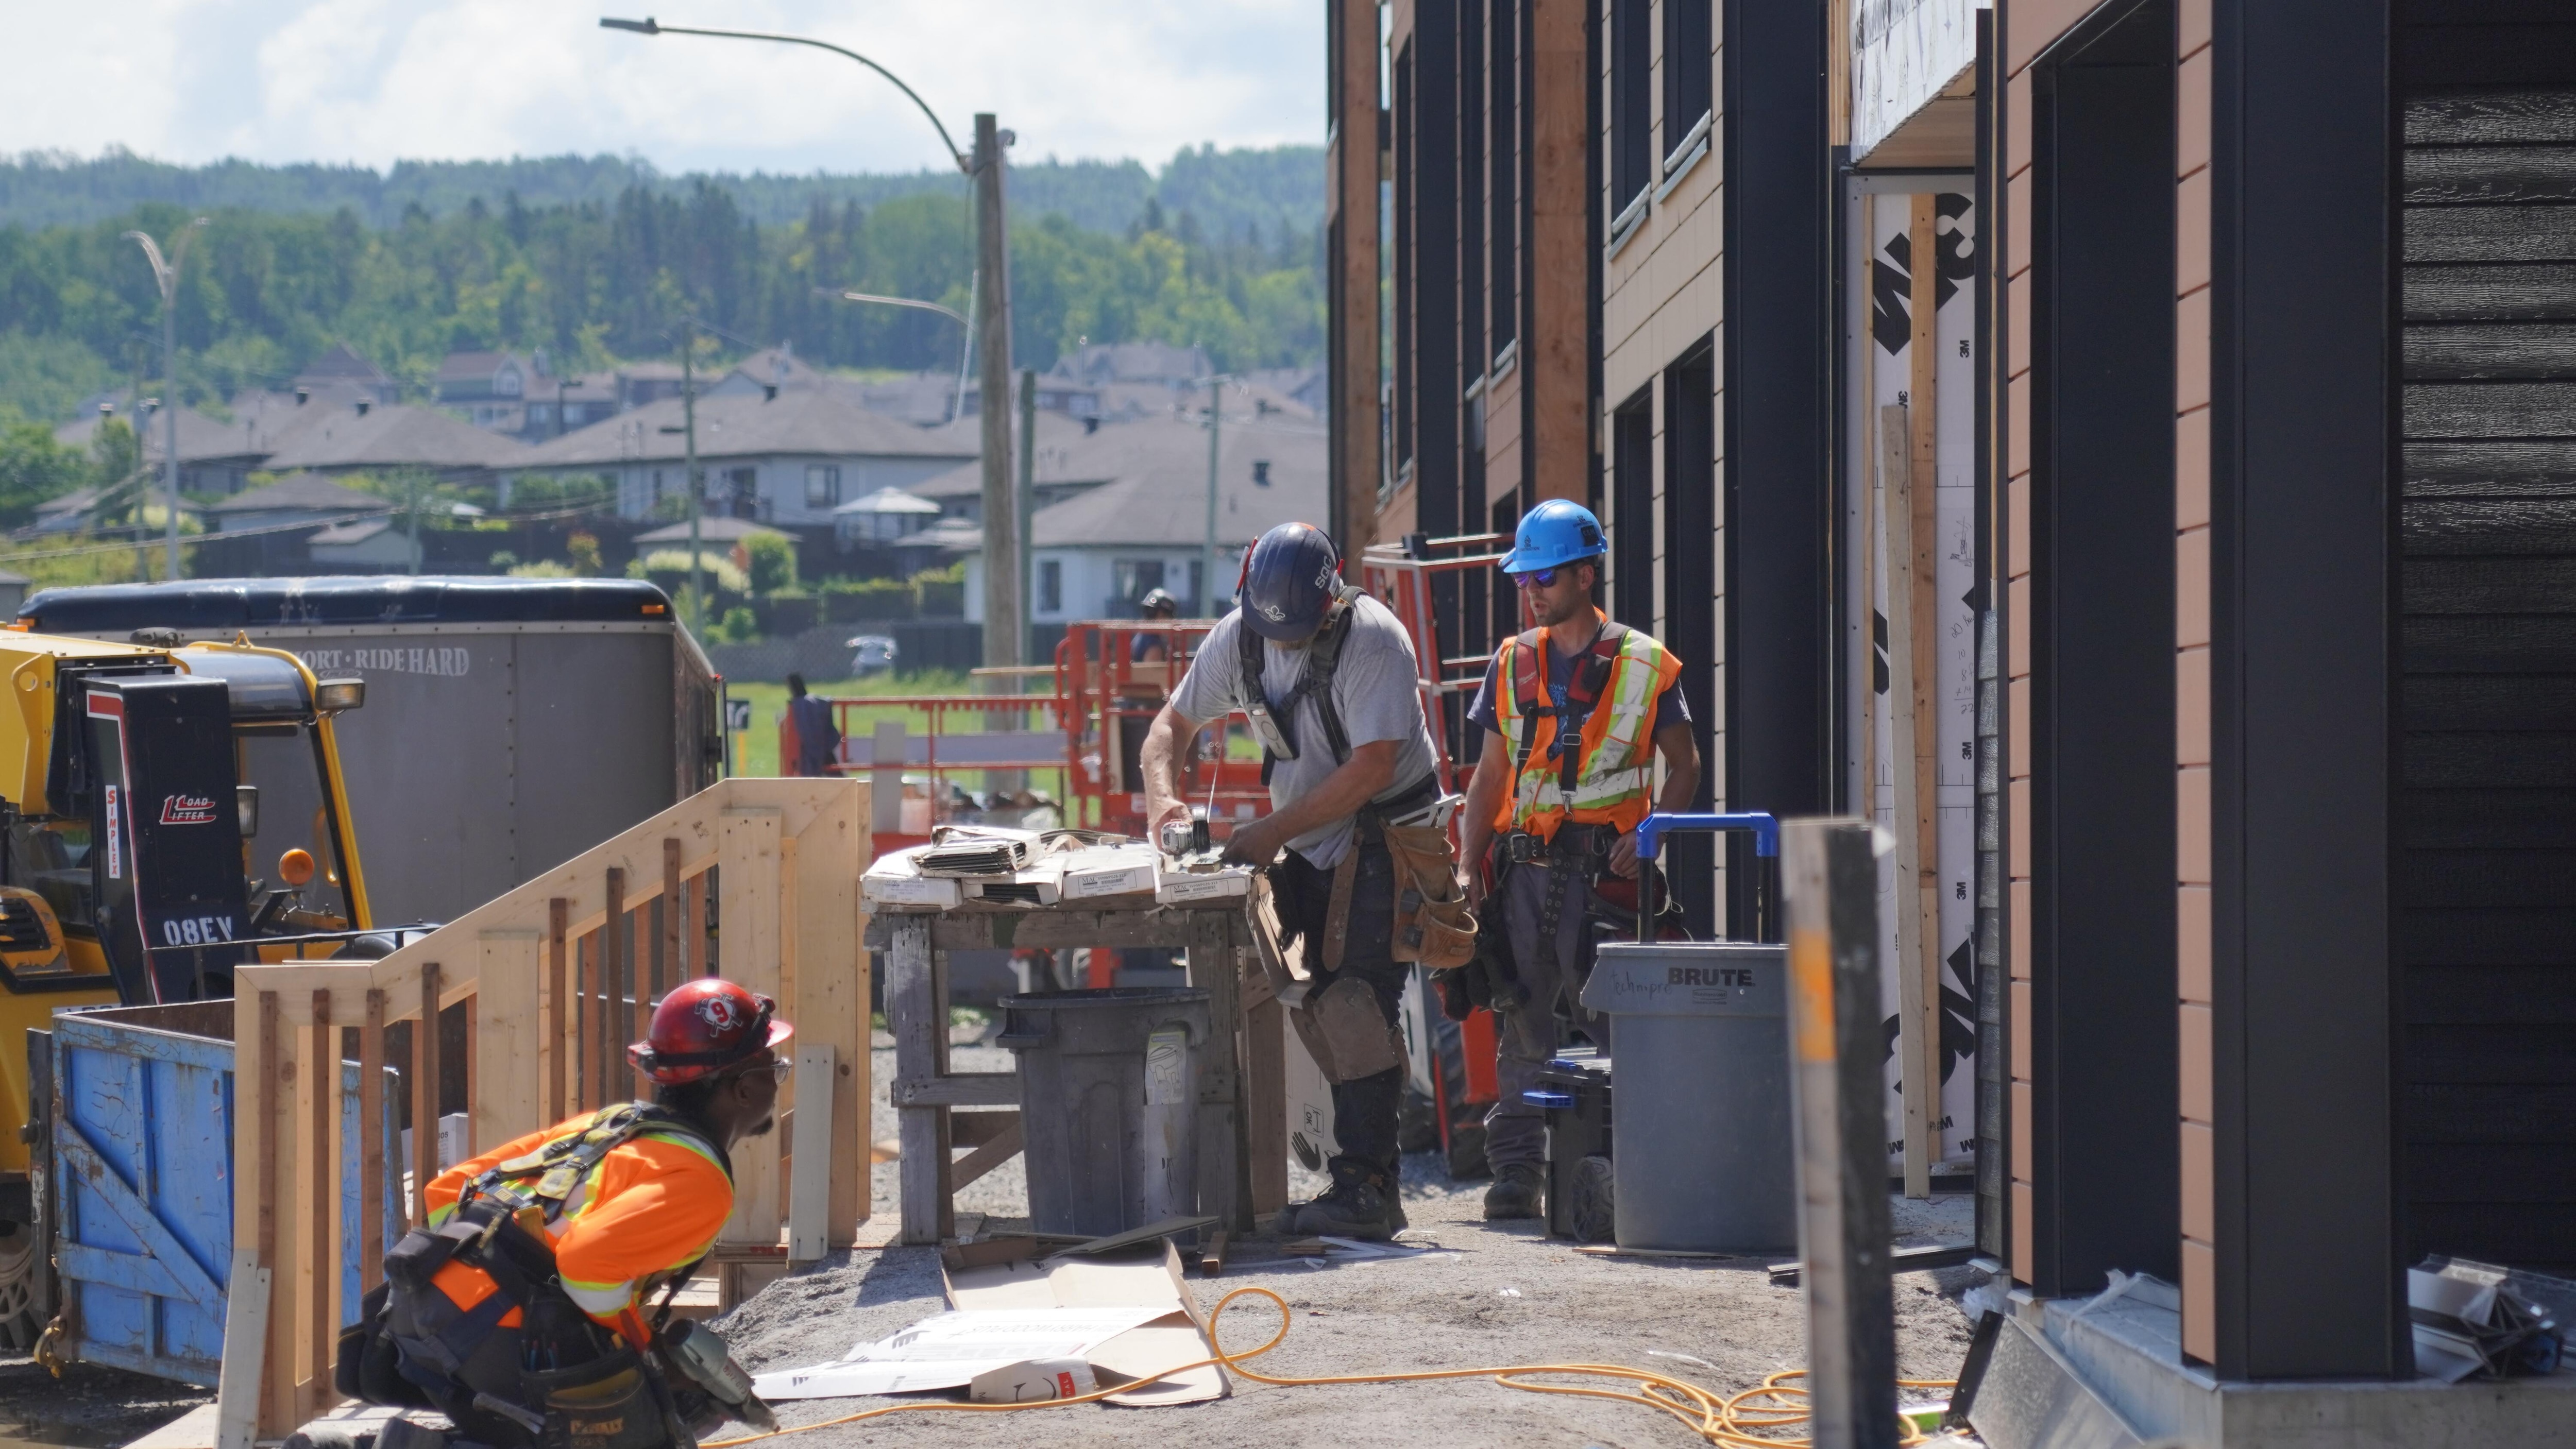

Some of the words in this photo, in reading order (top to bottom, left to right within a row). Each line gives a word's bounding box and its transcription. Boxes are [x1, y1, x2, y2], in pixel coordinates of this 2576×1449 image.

[1960, 340, 1969, 357] 3M
[1315, 555, 1332, 589] SQC
[354, 649, 404, 671] RIDE
[408, 647, 470, 677] HARD
[1962, 742, 1972, 760] 3M
[159, 795, 216, 825] LIFTER
[174, 795, 215, 811] LOAD
[107, 790, 118, 875] SIMPLEX
[1956, 882, 1966, 900] 3M
[1669, 967, 1753, 987] BRUTE
[711, 1001, 729, 1023] 9
[1306, 1111, 1313, 1126] OK
